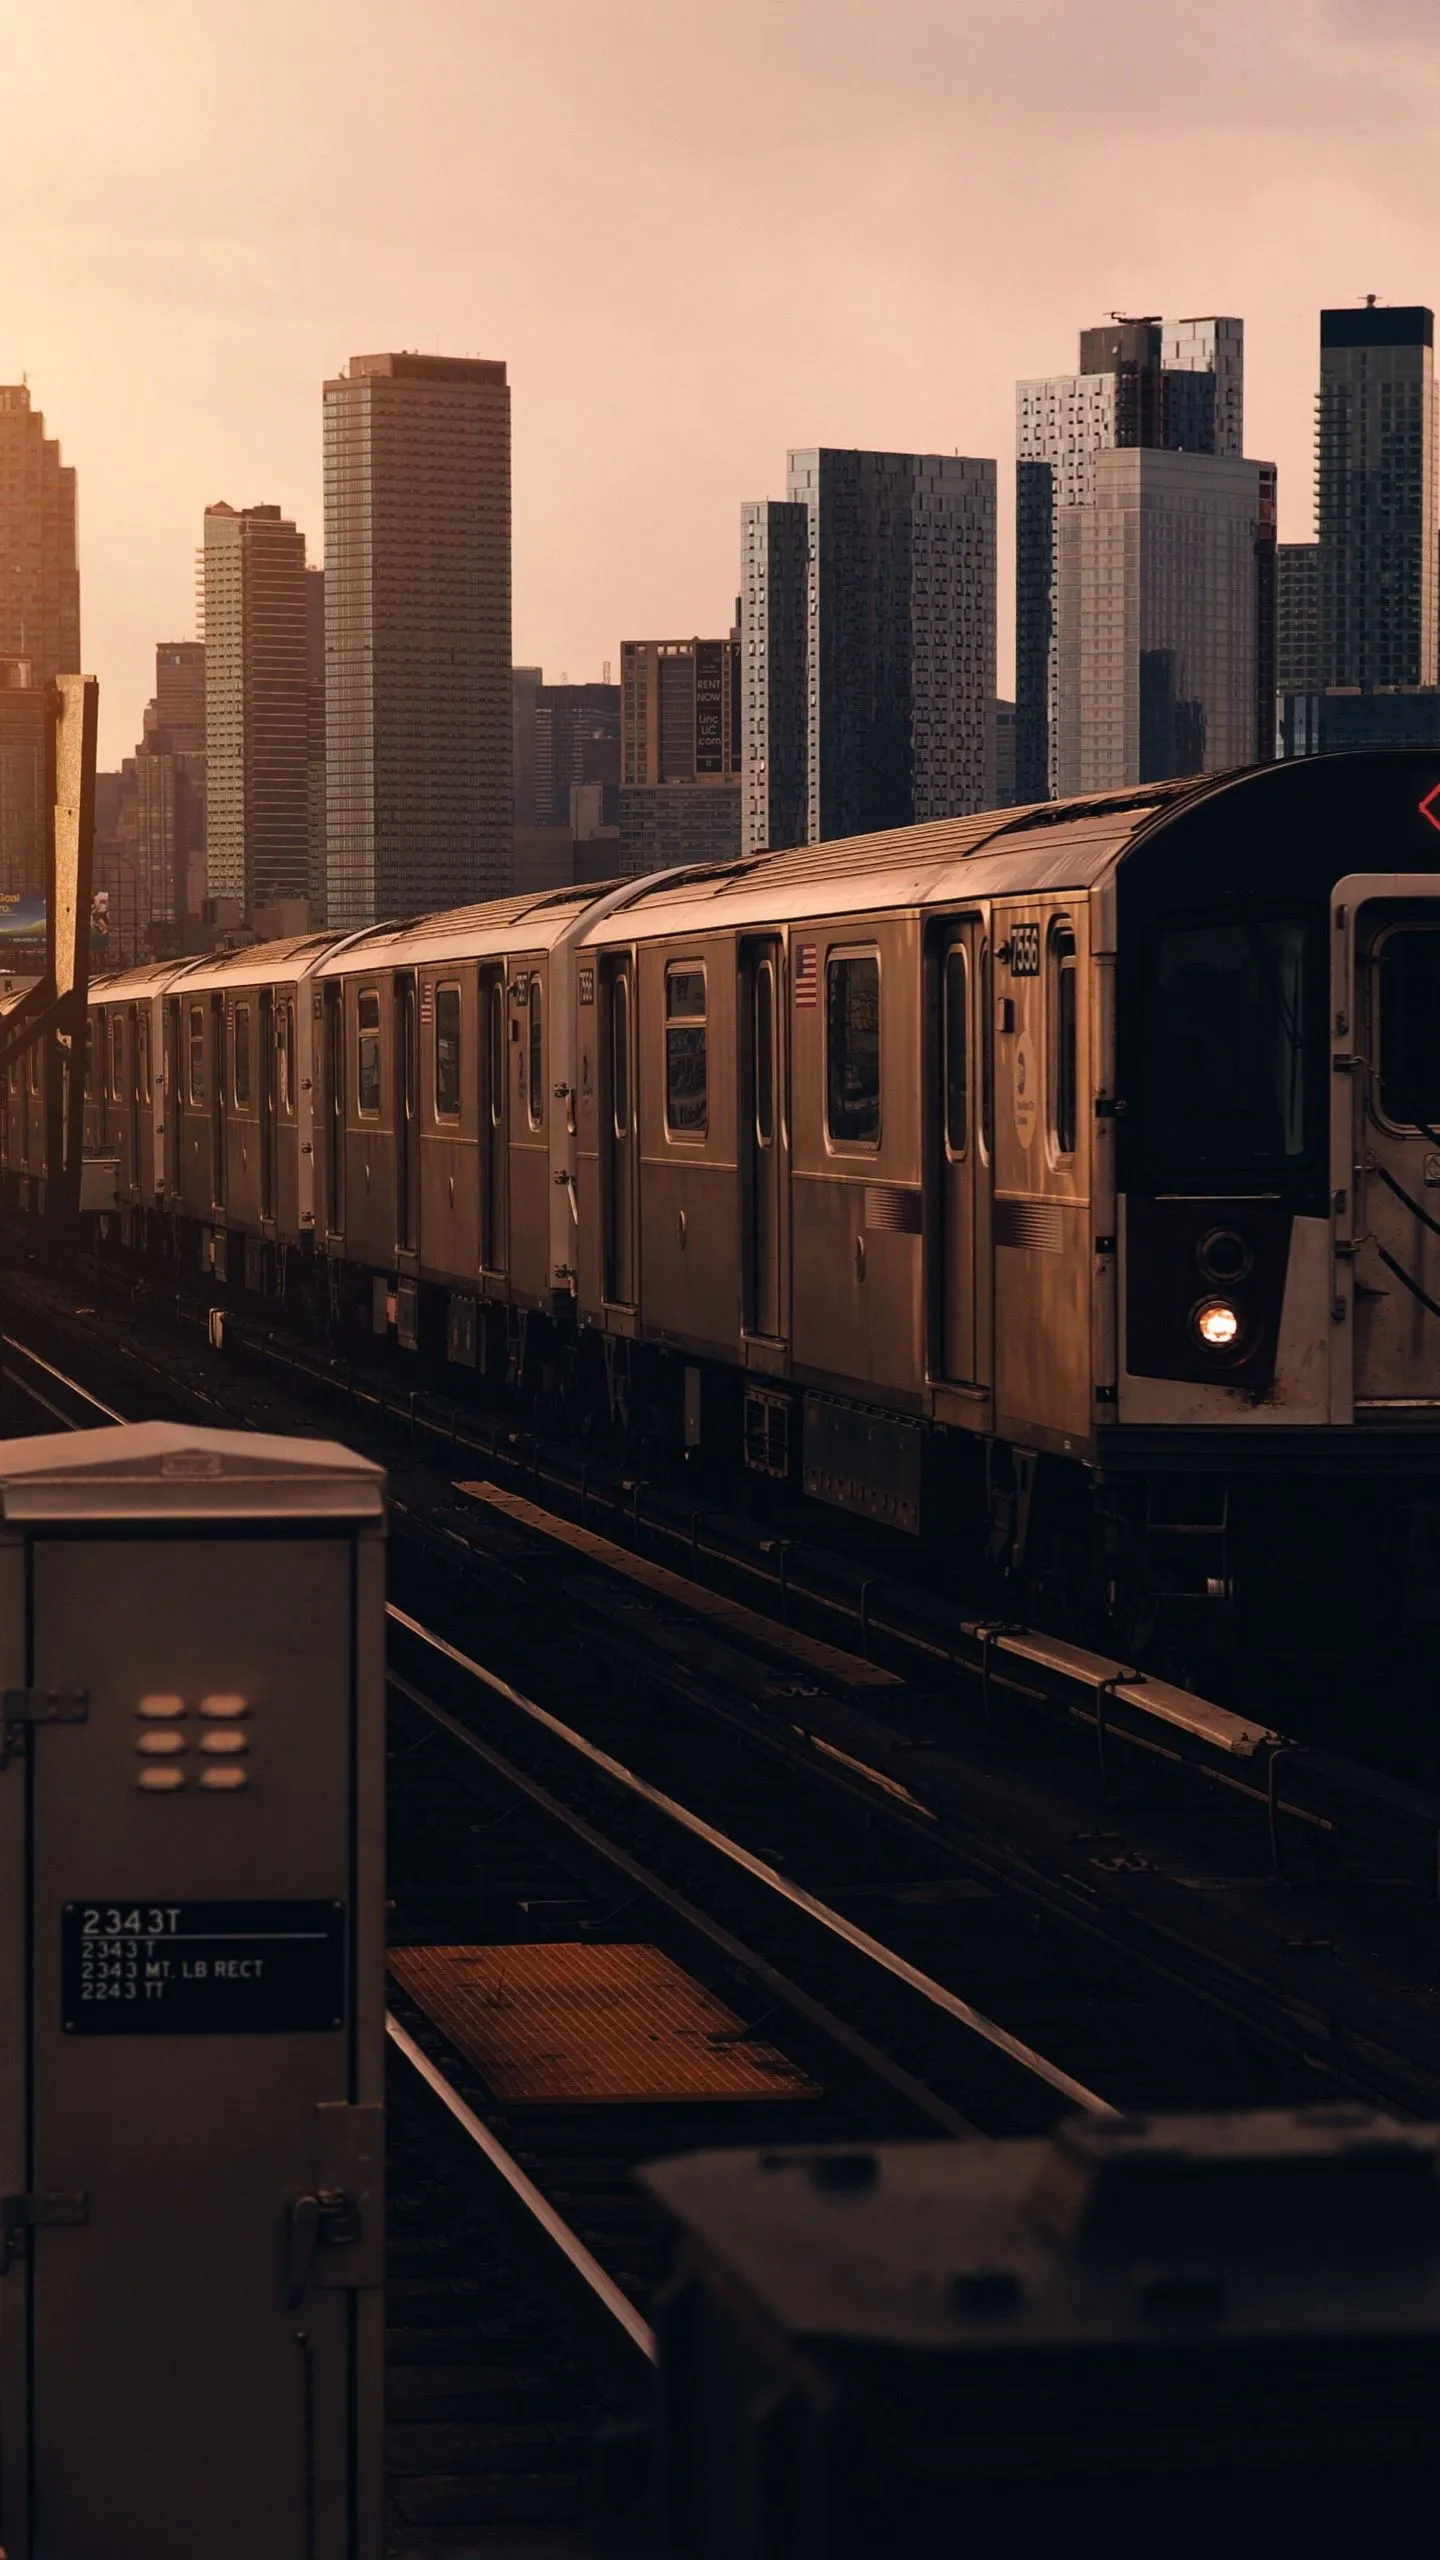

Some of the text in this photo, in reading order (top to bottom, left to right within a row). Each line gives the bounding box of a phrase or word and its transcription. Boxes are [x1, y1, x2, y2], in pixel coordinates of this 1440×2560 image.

[697, 680, 720, 689] RENT
[697, 692, 720, 701] NOW
[1012, 928, 1037, 971] 7556
[82, 1941, 155, 1958] 2343 T
[82, 1962, 138, 1979] 2343
[182, 1961, 207, 1978] LB
[214, 1960, 263, 1978] RECT
[82, 1982, 165, 1999] 2243 TT
